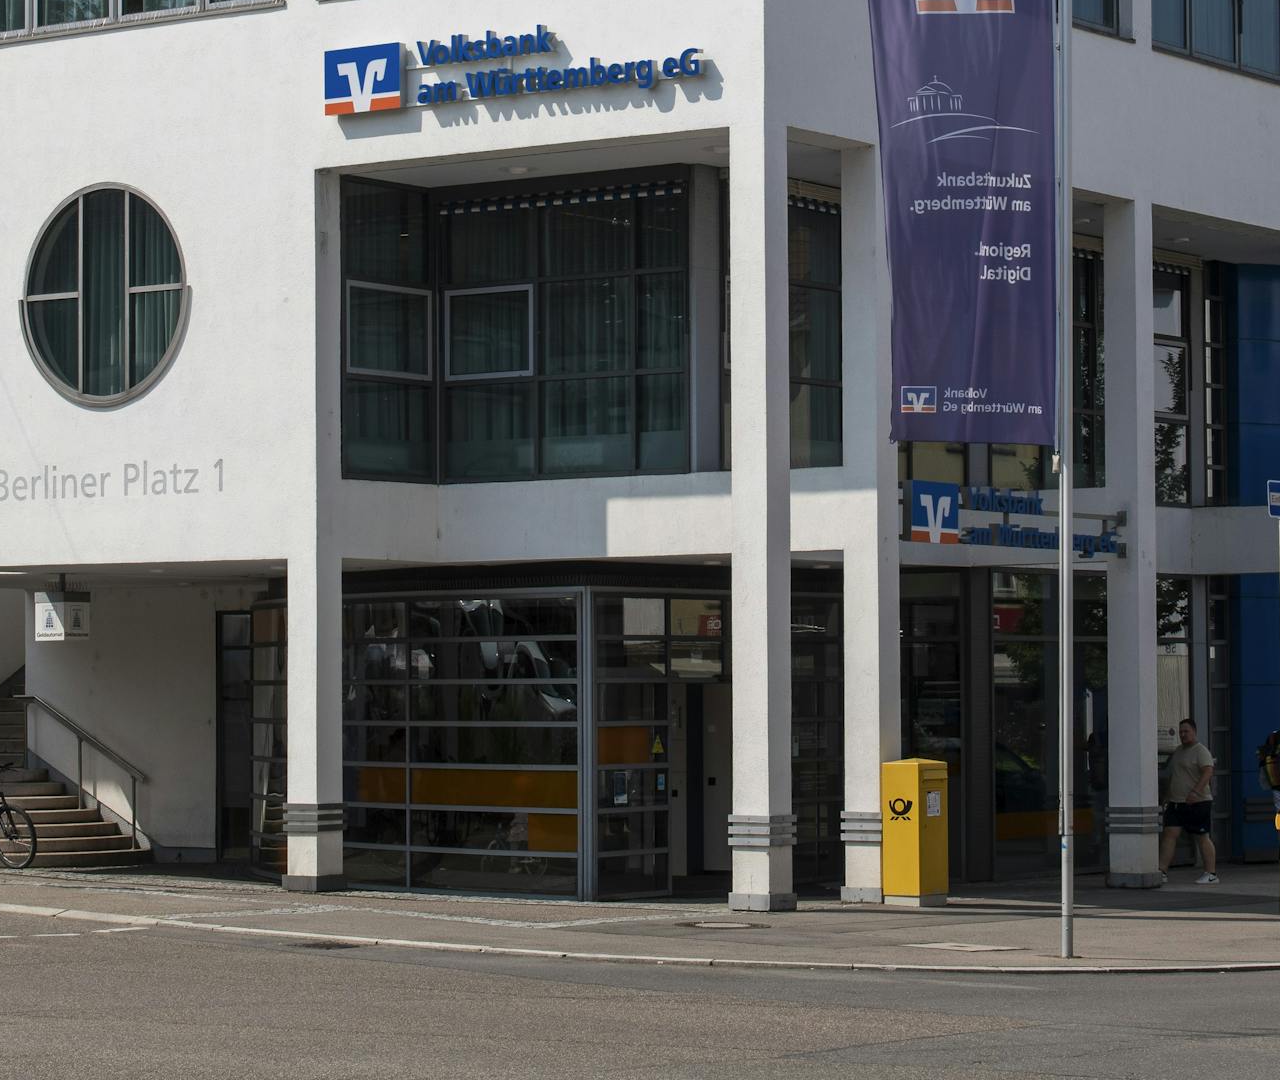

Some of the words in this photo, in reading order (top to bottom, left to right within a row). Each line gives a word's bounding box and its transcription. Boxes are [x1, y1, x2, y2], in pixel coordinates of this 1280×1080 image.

[417, 24, 555, 66] Volksbank
[418, 82, 457, 105] am
[466, 57, 654, 98] Württemberg
[663, 47, 703, 77] eG
[123, 460, 200, 496] Platz
[213, 458, 224, 492] 1
[971, 487, 1044, 515] Volksbank
[970, 527, 992, 545] am
